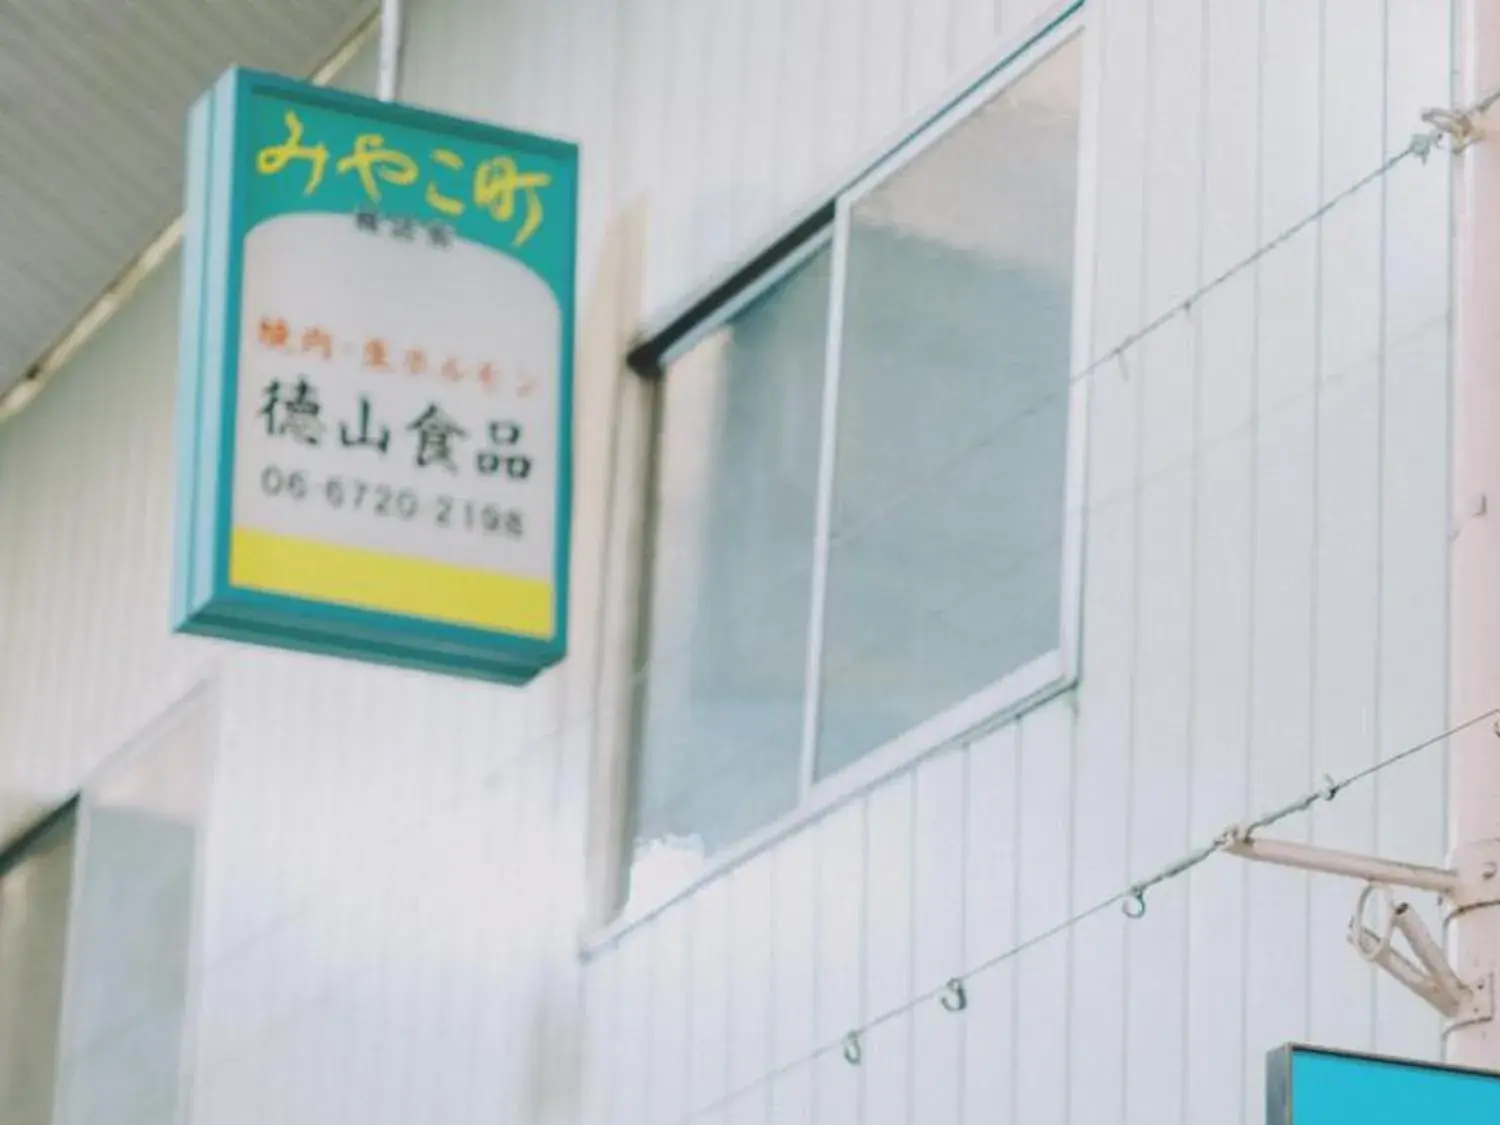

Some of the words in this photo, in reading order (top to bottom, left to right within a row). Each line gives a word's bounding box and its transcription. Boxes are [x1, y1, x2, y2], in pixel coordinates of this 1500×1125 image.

[256, 110, 551, 246] みやこ町
[256, 376, 533, 482] 徳山食品
